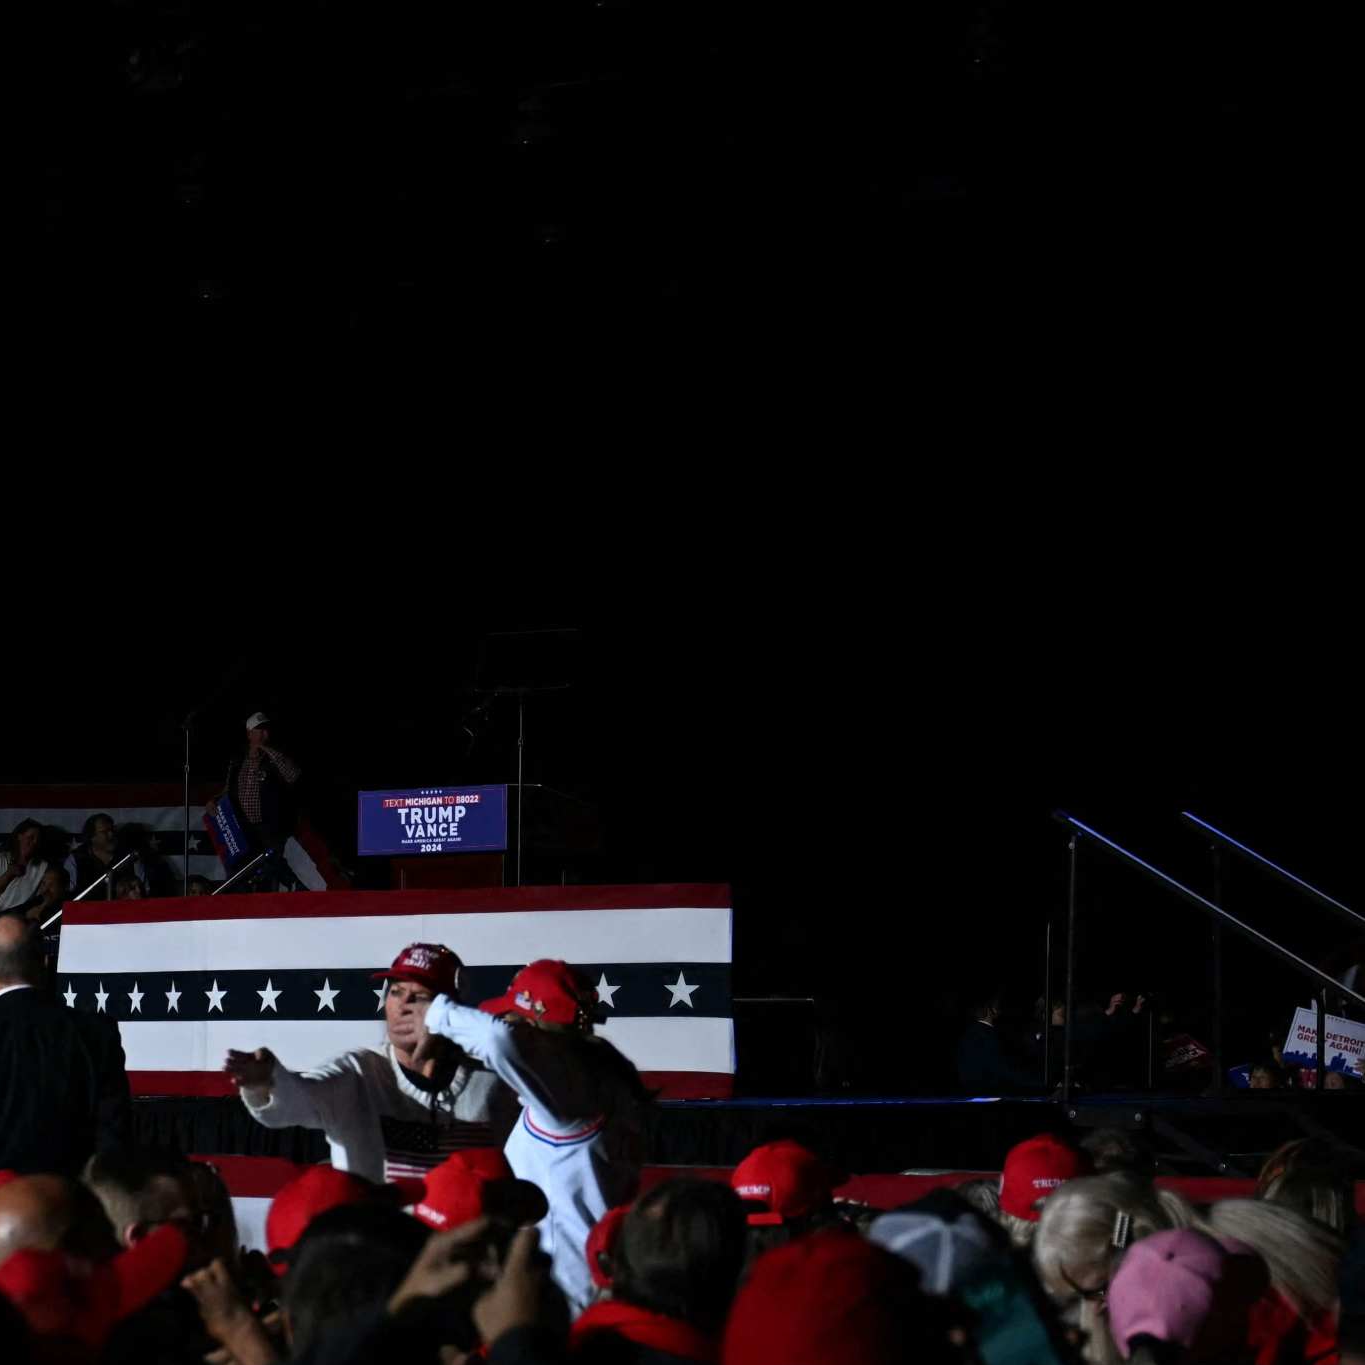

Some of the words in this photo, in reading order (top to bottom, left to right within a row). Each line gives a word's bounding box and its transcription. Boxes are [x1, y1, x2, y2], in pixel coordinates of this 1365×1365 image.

[384, 799, 404, 808] TEXT
[405, 797, 442, 806] MICHIGAN
[398, 805, 466, 825] TRUMP
[405, 823, 458, 838] VANCE
[421, 844, 442, 852] 2024
[1297, 1025, 1318, 1036] MAK
